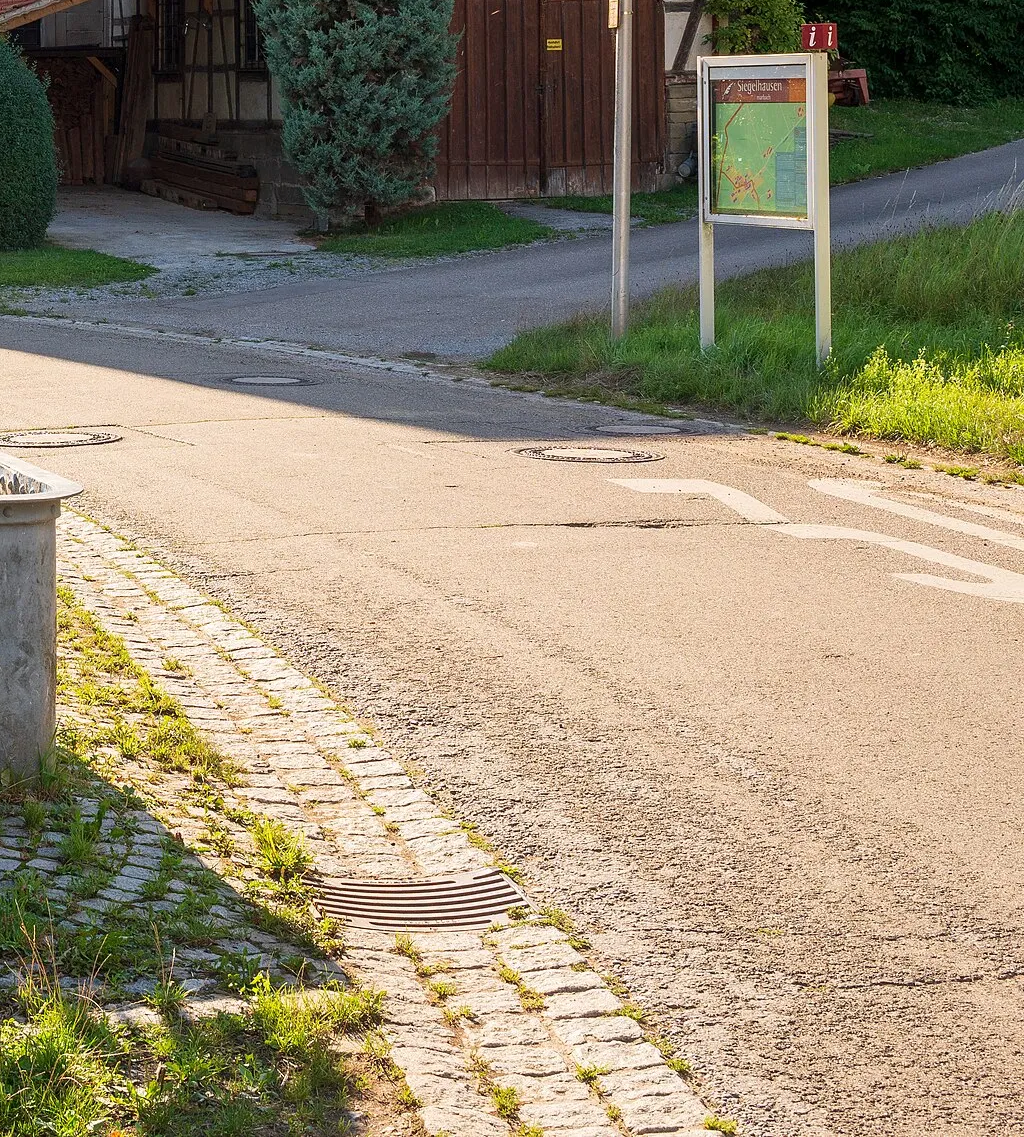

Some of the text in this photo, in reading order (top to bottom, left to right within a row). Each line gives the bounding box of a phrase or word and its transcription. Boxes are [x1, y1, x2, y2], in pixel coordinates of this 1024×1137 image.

[809, 26, 816, 46] i
[827, 25, 833, 46] i
[737, 80, 782, 94] Siegelhausen
